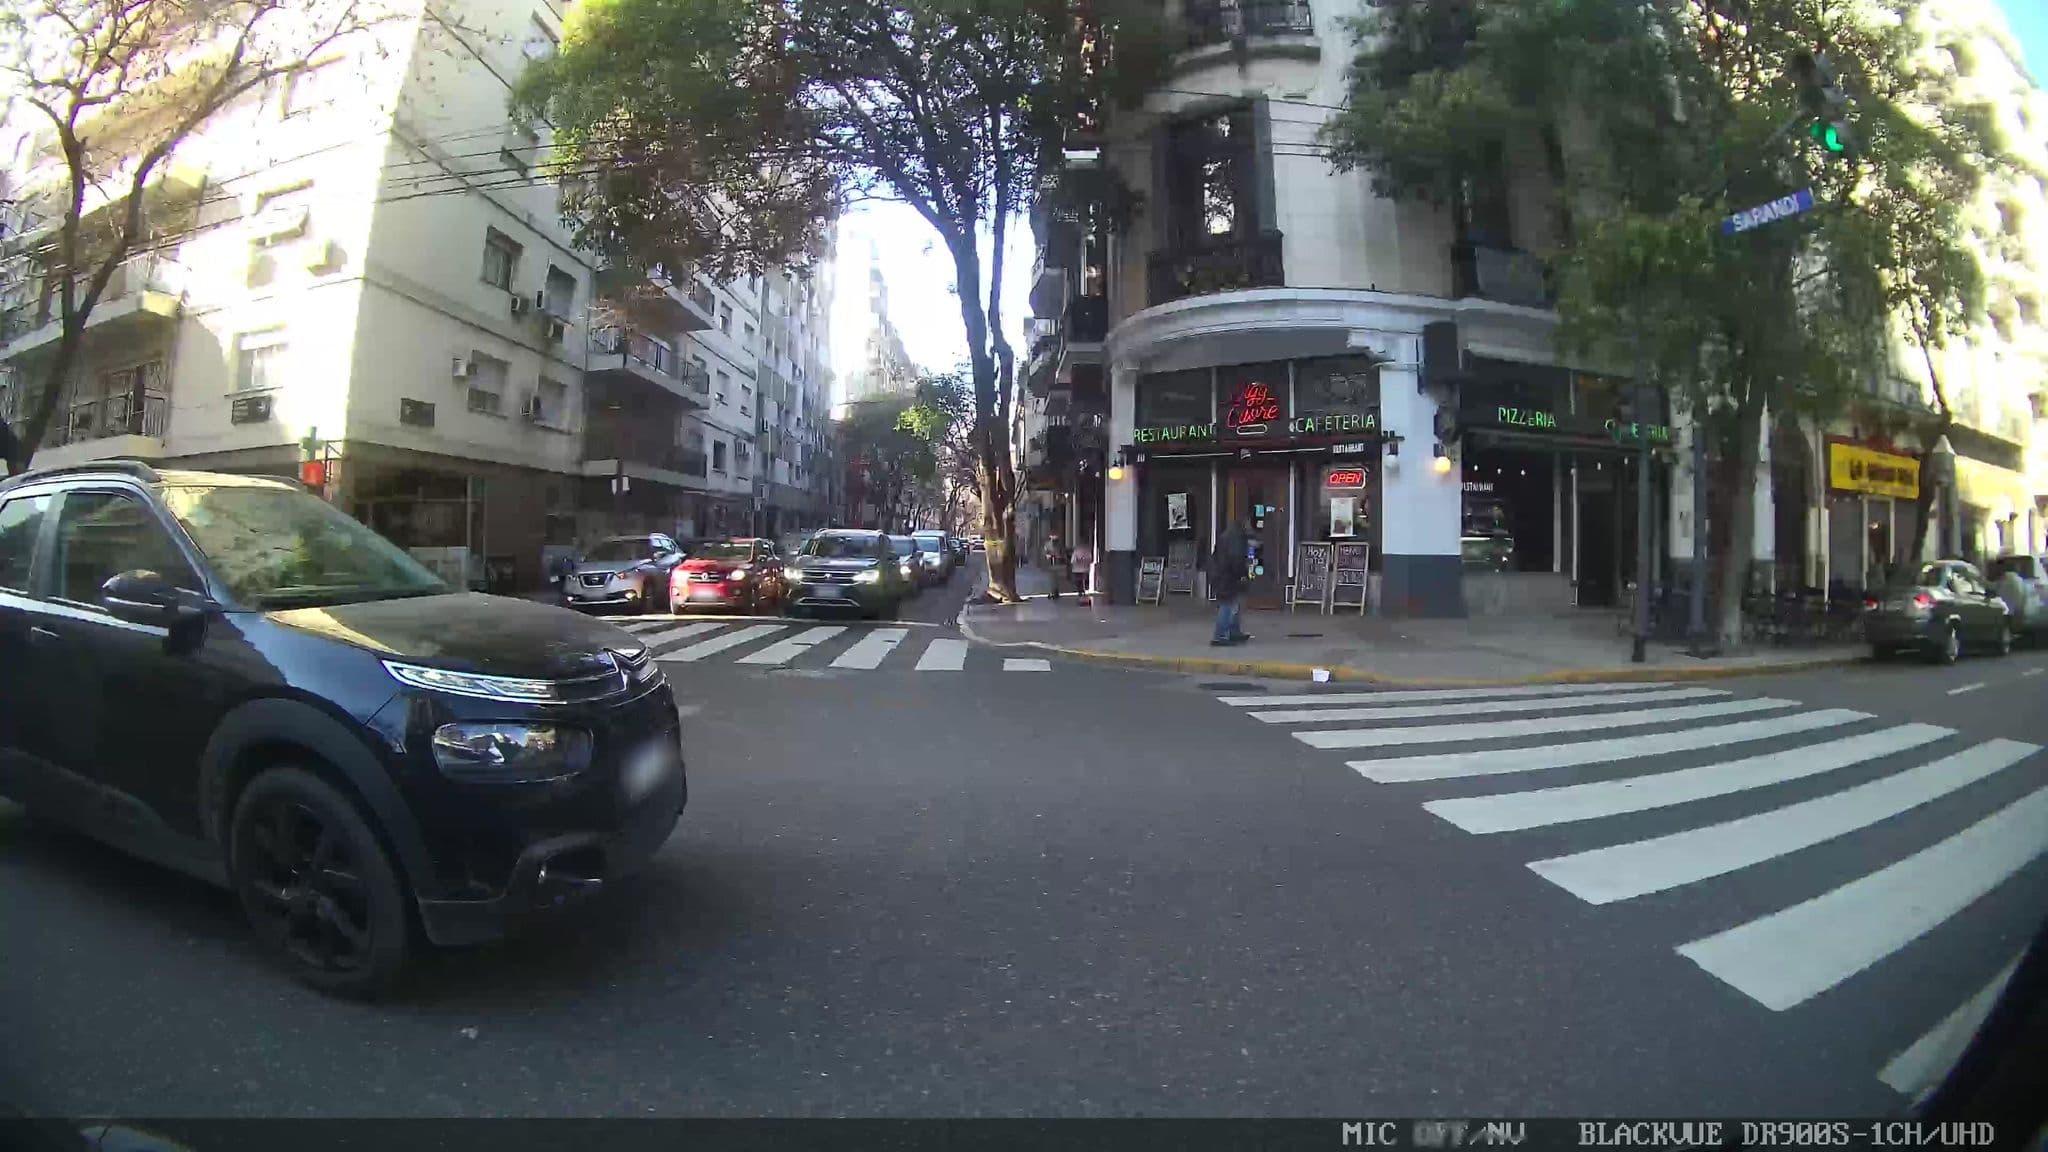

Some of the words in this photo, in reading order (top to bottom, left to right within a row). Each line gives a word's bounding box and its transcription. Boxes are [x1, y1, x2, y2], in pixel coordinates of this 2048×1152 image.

[1295, 413, 1376, 433] CAFETERIA
[1498, 406, 1557, 428] PIZZERIA
[1133, 422, 1217, 443] RESTAURANT
[1329, 472, 1362, 485] OPEN
